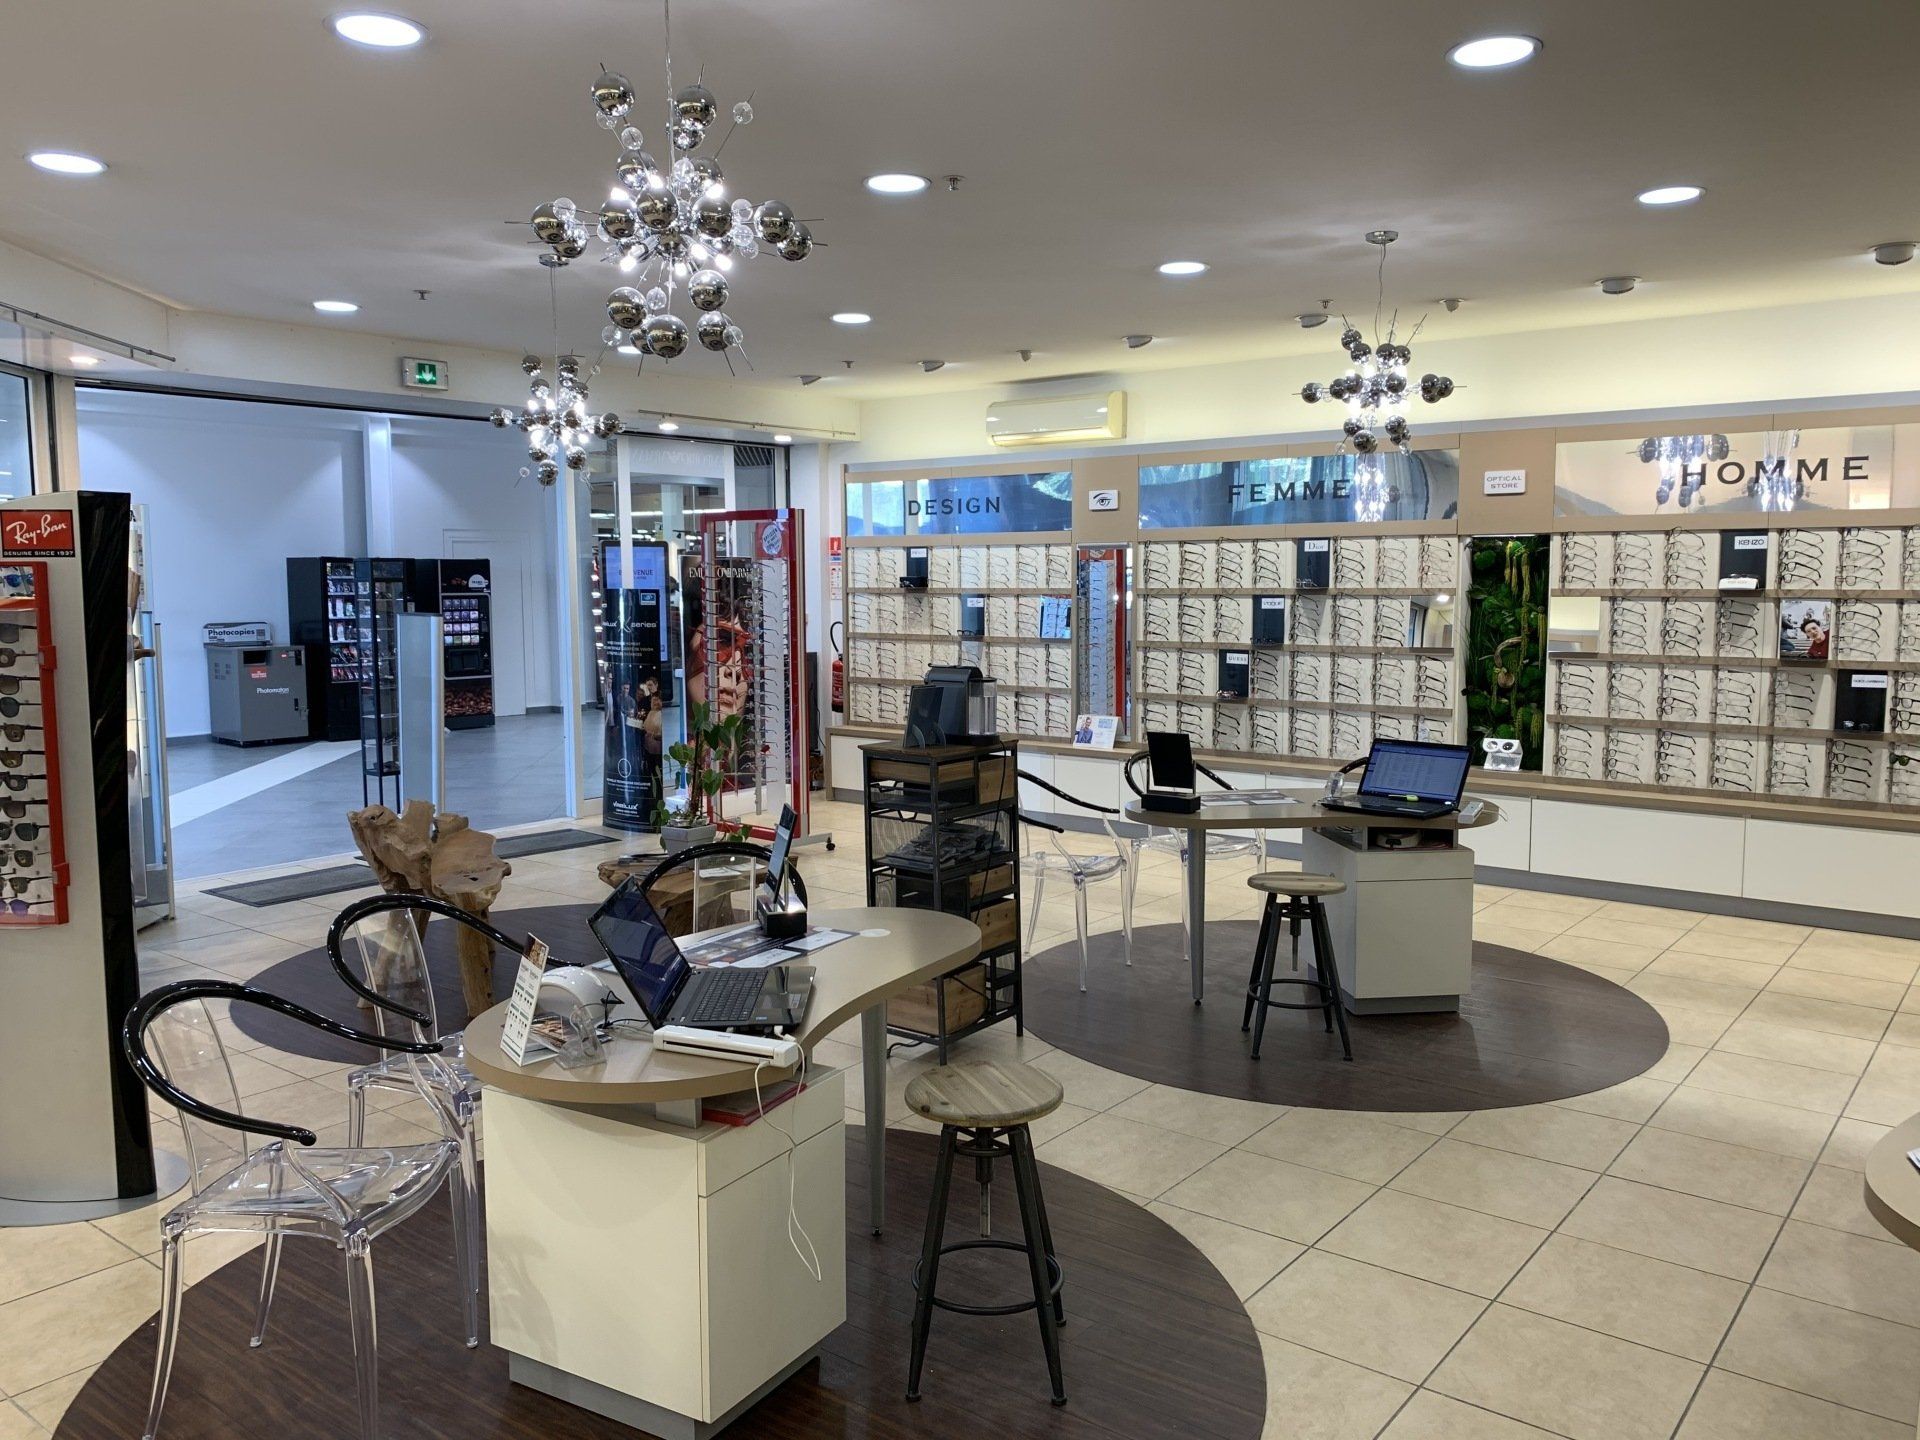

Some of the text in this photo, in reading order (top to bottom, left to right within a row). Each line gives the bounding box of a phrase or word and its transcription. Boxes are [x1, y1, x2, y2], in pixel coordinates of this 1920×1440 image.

[1681, 455, 1870, 487] HOMME
[1228, 479, 1351, 504] FEMME
[908, 496, 1001, 516] DESIGN
[6, 514, 67, 545] Ray-Ban
[1738, 538, 1765, 546] KENZO
[208, 628, 255, 637] Photocopies
